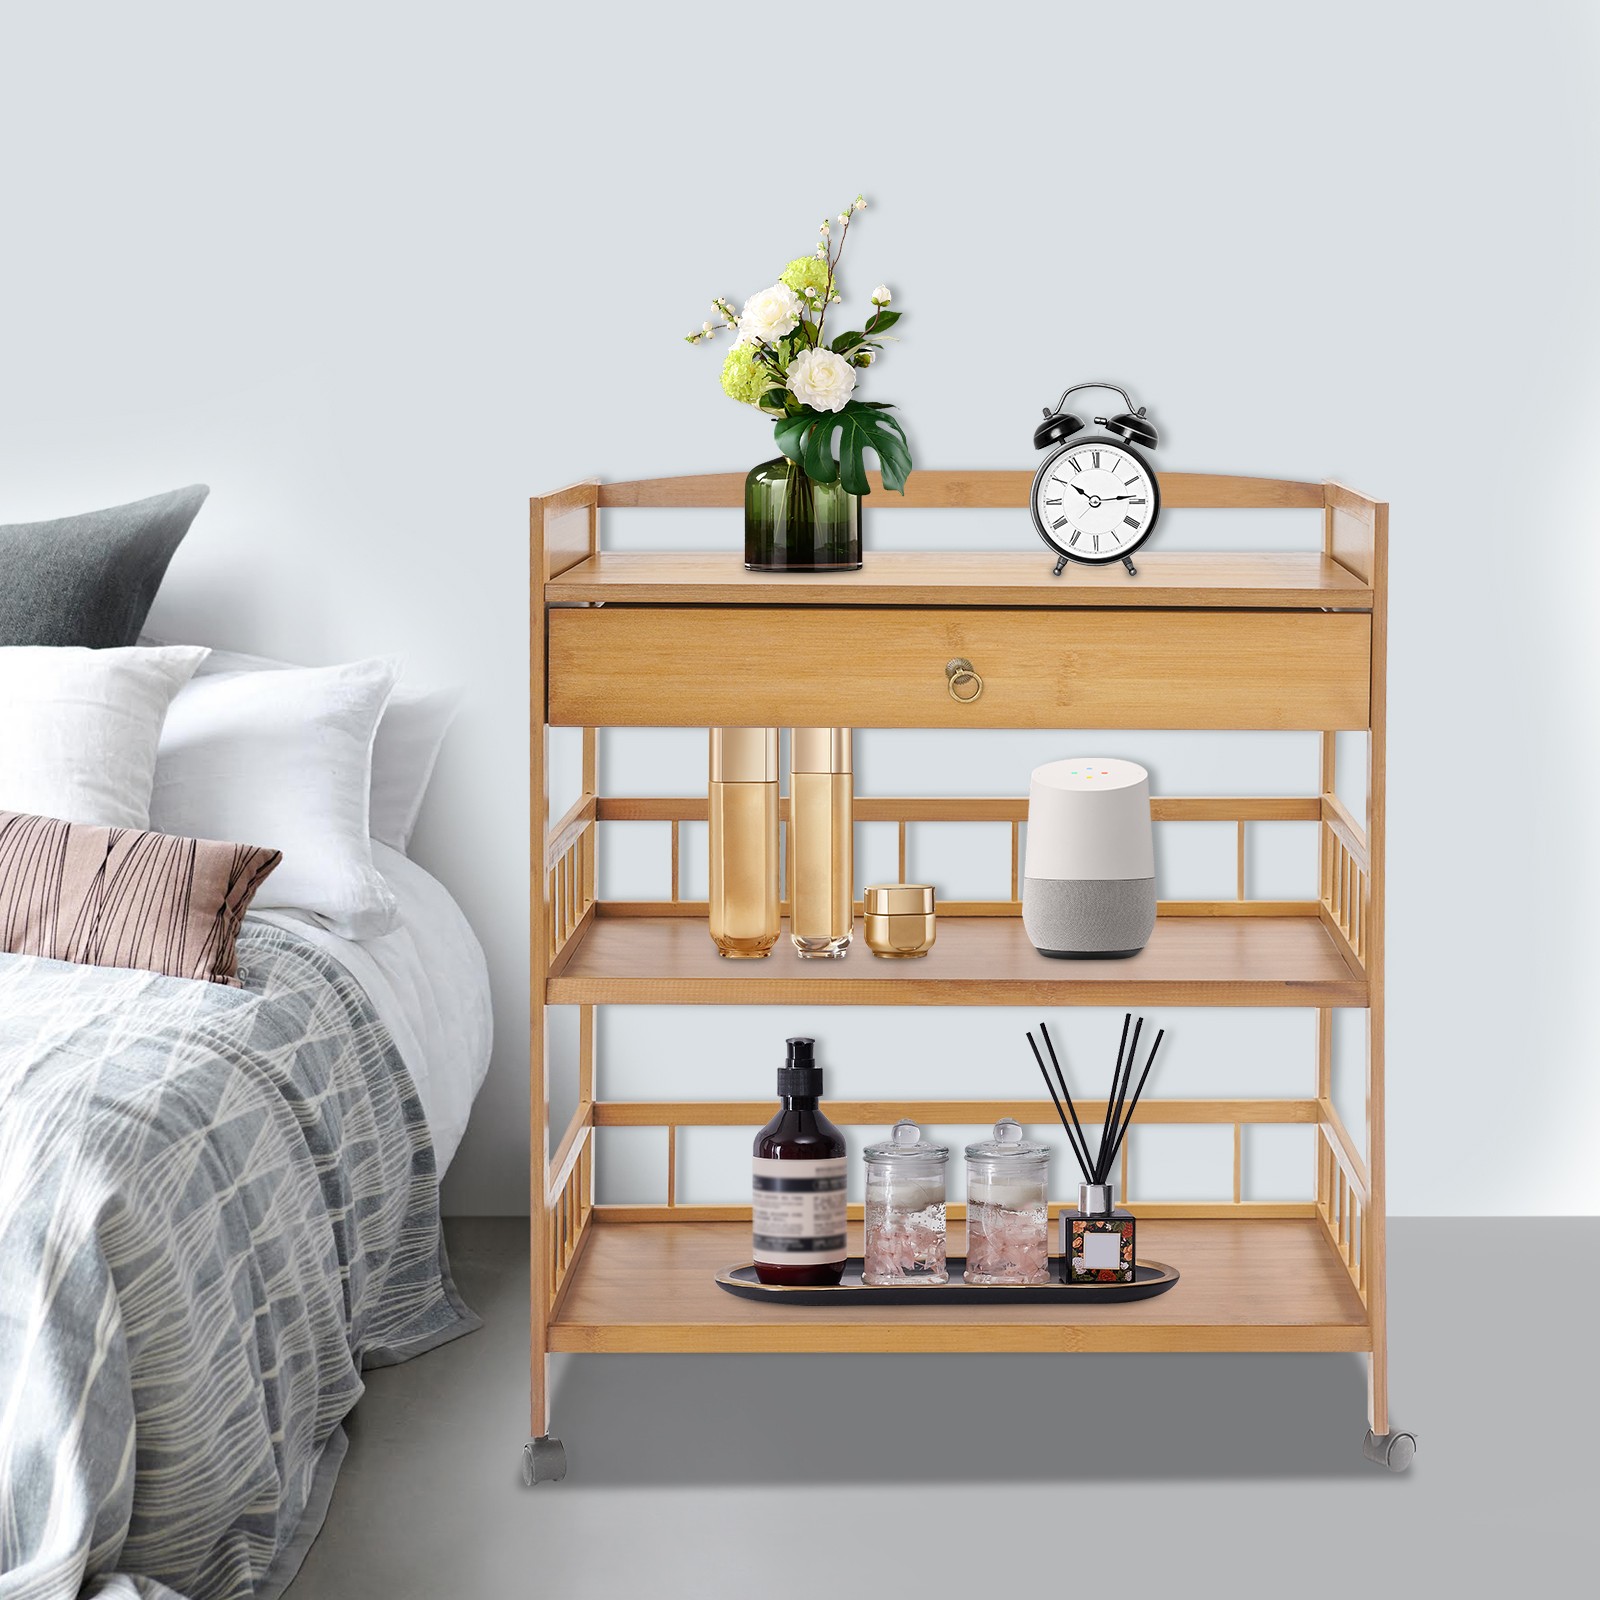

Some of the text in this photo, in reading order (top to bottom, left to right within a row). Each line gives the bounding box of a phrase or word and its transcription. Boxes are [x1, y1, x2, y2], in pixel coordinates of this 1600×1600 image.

[1068, 457, 1082, 475] XI
[1052, 475, 1068, 487] X
[1124, 476, 1139, 486] II
[1052, 515, 1068, 530] VIII
[1069, 530, 1081, 546] VII
[1093, 535, 1098, 551] VI
[1111, 530, 1120, 544] V
